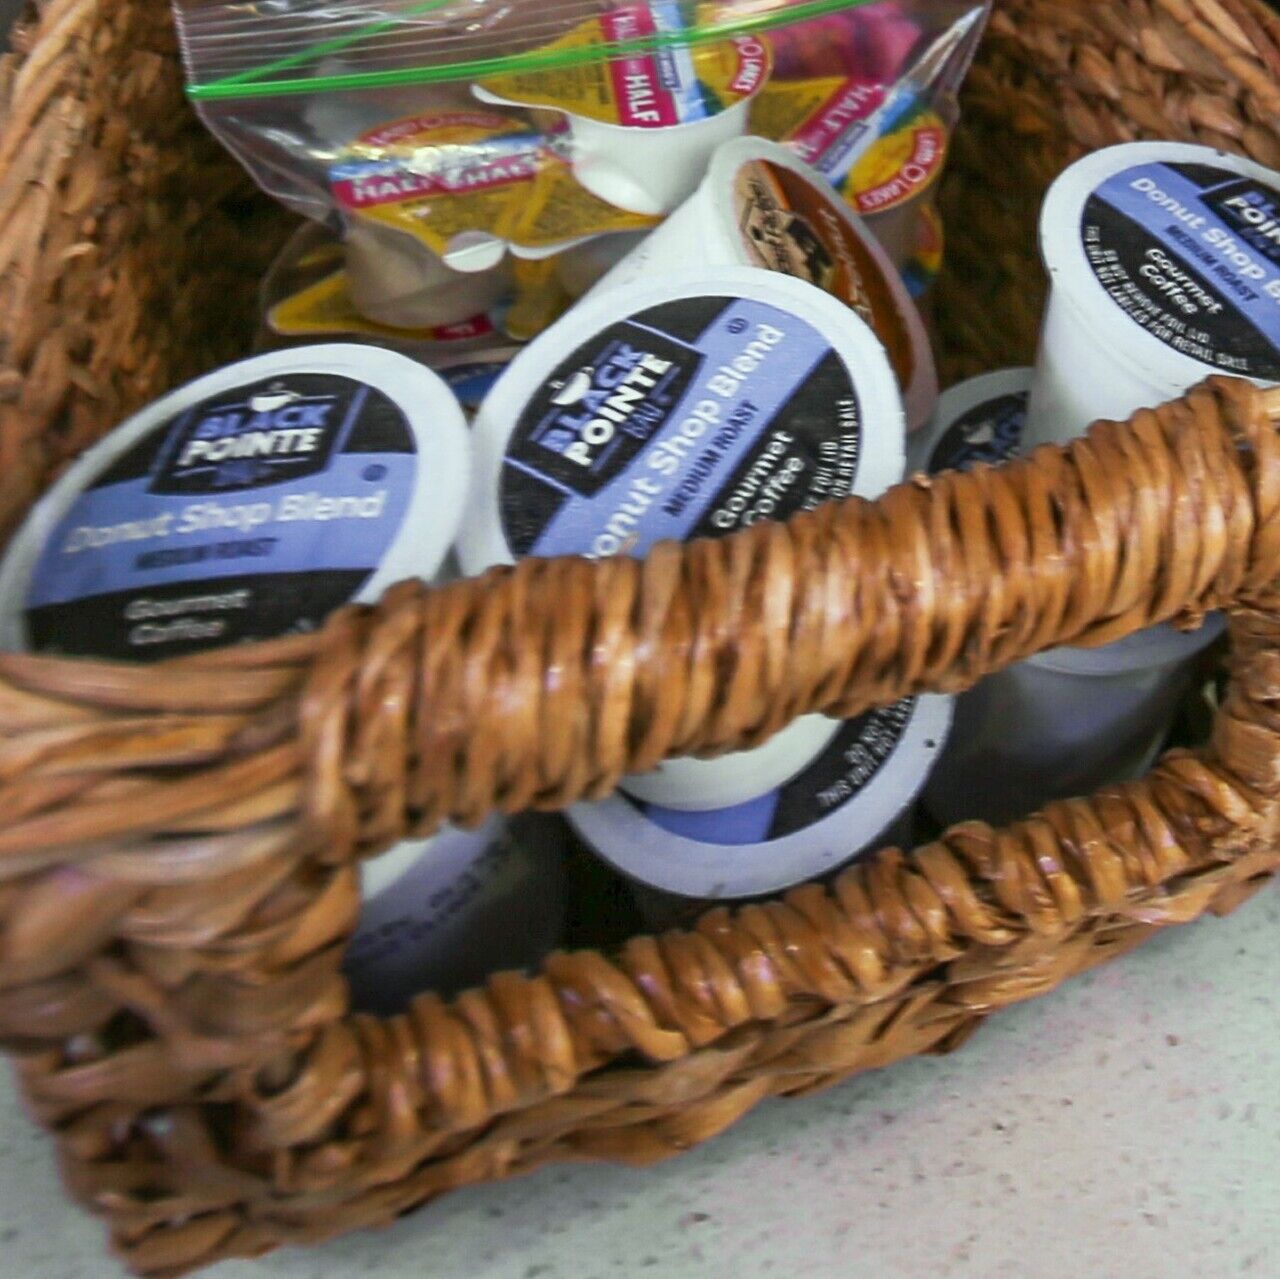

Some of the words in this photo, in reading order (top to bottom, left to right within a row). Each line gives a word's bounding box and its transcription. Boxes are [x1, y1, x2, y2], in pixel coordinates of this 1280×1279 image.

[624, 74, 660, 123] HALF
[1129, 177, 1208, 230] Donut
[1201, 227, 1266, 280] Shop
[1138, 263, 1199, 315] Coffee
[1144, 247, 1223, 315] Gourmet
[1164, 224, 1218, 266] MEDIUM
[1213, 264, 1259, 302] ROAST
[194, 403, 333, 441] BLACK
[536, 343, 646, 453] BLACK
[563, 353, 674, 467] POINTE
[834, 399, 859, 428] SALE
[176, 427, 326, 467] POINTE
[580, 477, 664, 558] onut
[647, 398, 721, 477] Shop
[706, 323, 785, 398] Blend
[661, 447, 722, 518] MEDIUM
[713, 399, 759, 450] ROAST
[818, 441, 840, 463] LID
[834, 433, 859, 478] RETAIL
[710, 430, 795, 529] Gourmet
[62, 512, 174, 553] Donut
[175, 501, 271, 533] Shop
[276, 489, 388, 521] Blend
